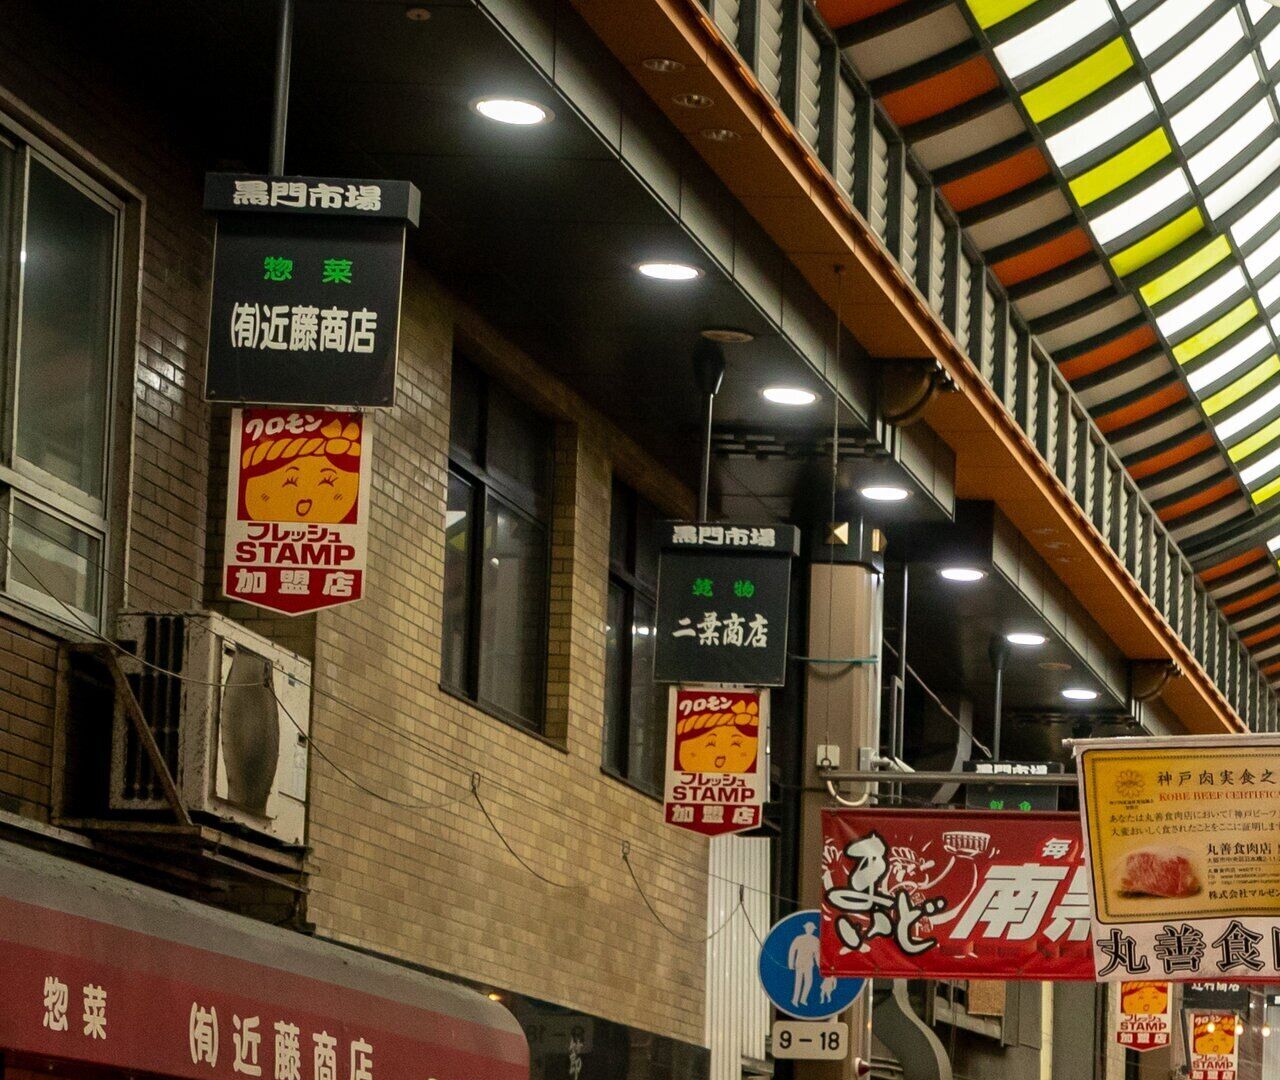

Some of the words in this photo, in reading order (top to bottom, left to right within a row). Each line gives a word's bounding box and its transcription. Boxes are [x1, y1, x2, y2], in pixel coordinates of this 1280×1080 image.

[233, 181, 381, 211] 黒門市場
[245, 413, 322, 441] クロモン
[248, 523, 341, 544] フレッシュ
[672, 525, 776, 547] 黒門市場
[235, 541, 356, 566] STAMP
[235, 568, 355, 597] 加盟店
[672, 611, 769, 648] 二葉商店
[679, 695, 733, 716] クロモン
[681, 772, 746, 788] フレッシュ
[673, 786, 755, 802] STAMP
[1159, 790, 1190, 802] KOBE
[1193, 790, 1223, 801] BEEF
[1206, 842, 1272, 856] 丸善食肉店
[43, 976, 108, 1040] 惣菜
[1120, 1021, 1168, 1031] STAMP
[1192, 1060, 1234, 1069] STAMP
